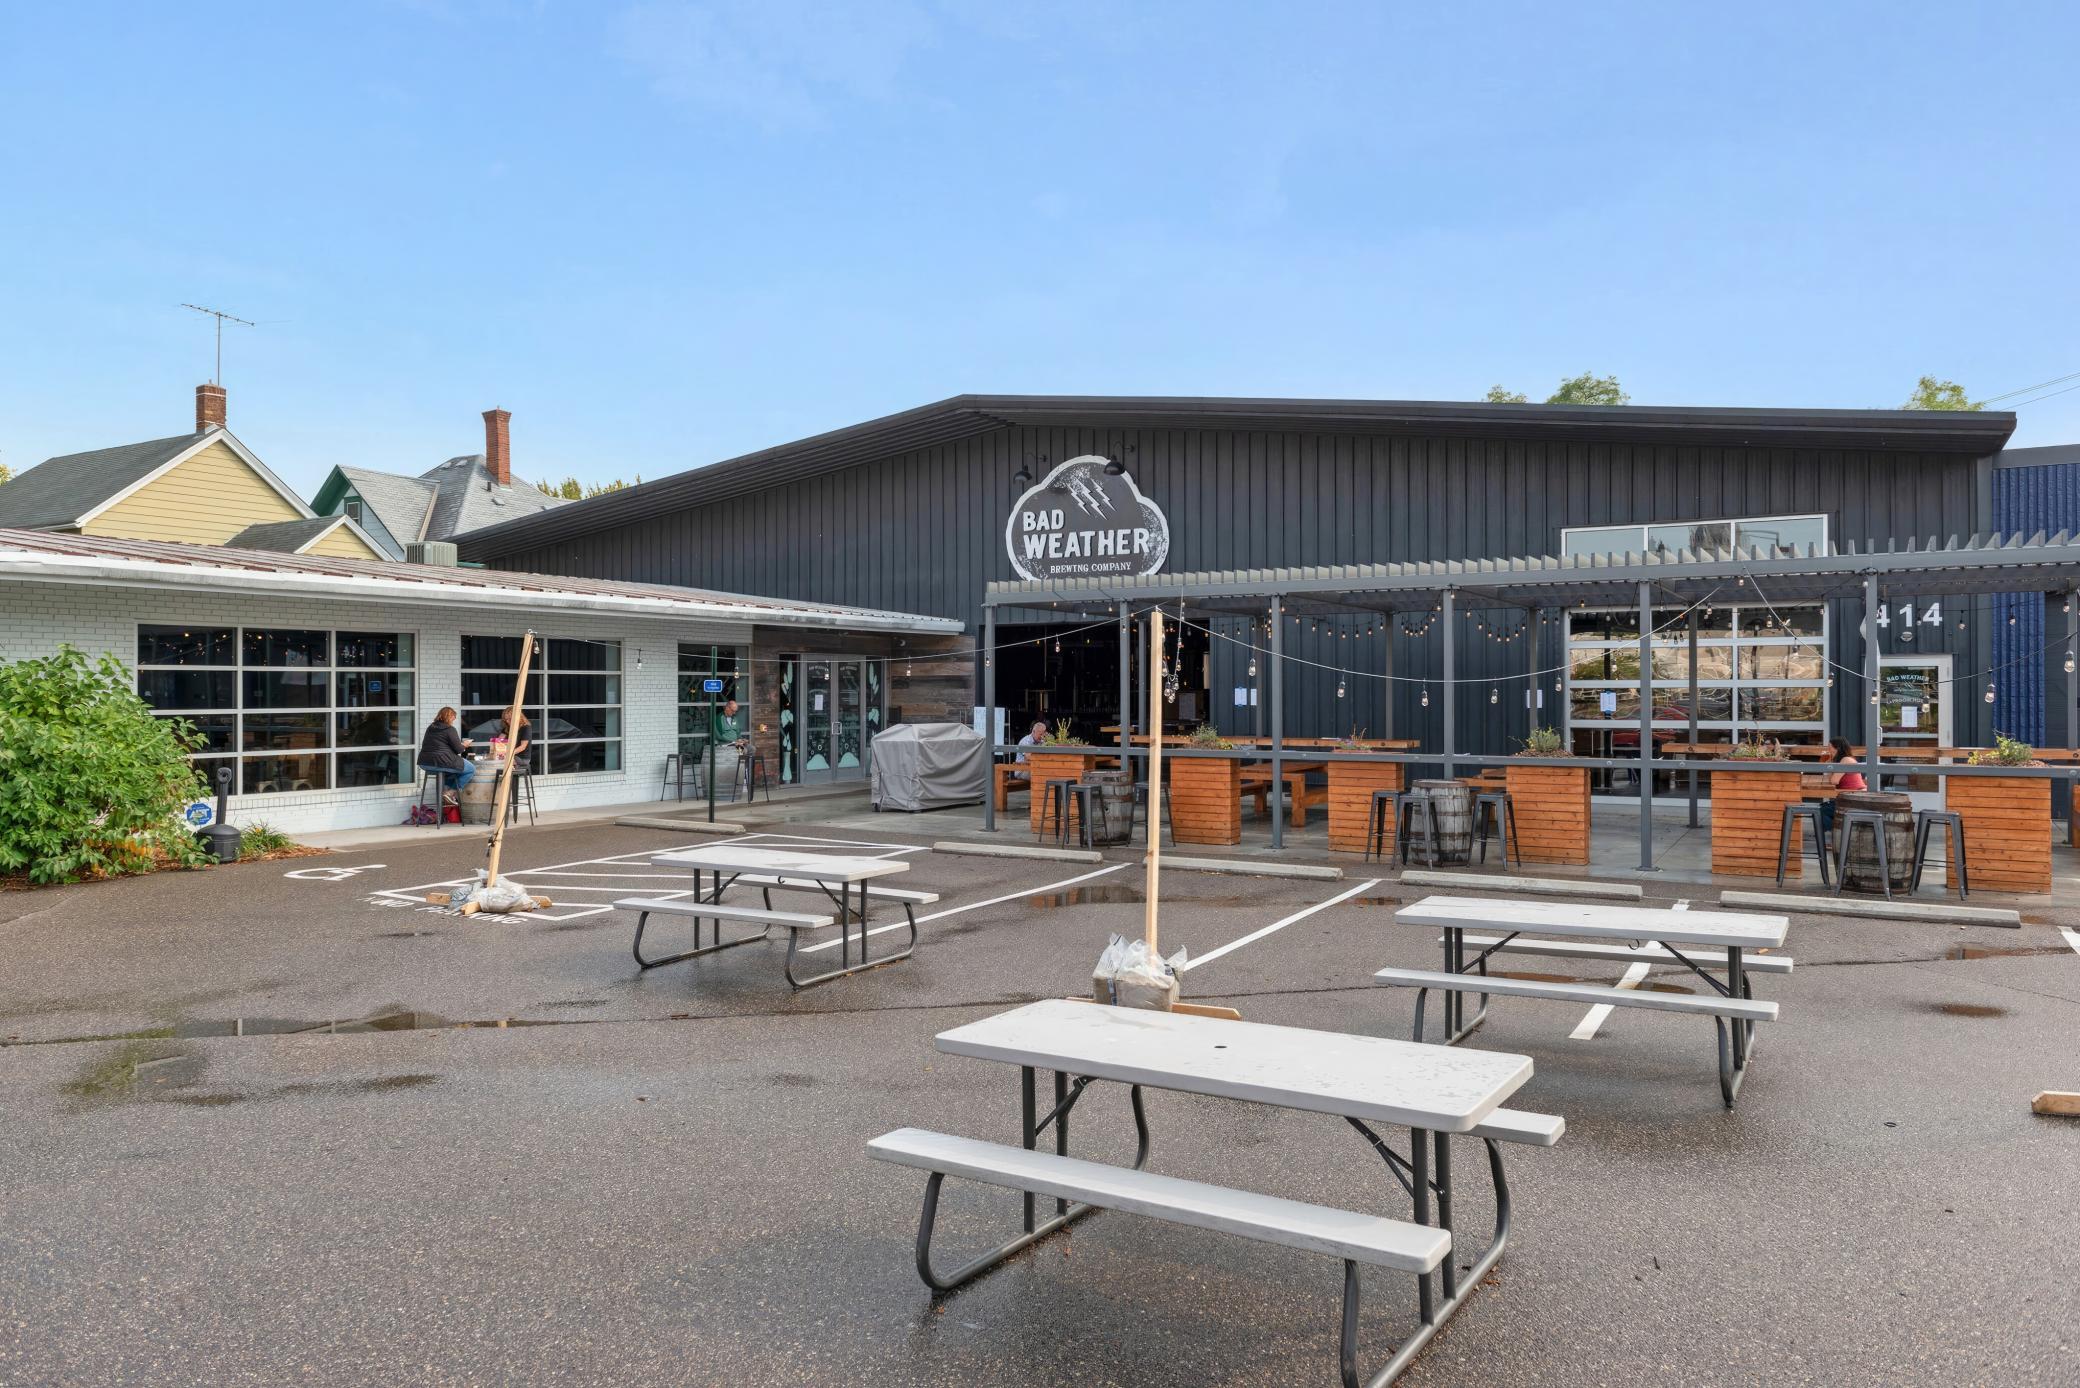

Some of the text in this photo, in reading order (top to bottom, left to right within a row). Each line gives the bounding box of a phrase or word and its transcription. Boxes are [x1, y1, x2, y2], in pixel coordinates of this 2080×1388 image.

[1023, 509, 1065, 531] BAD
[1023, 528, 1150, 559] WEATHER
[1050, 562, 1132, 573] BREWING COMPANY
[1877, 603, 1942, 628] 414
